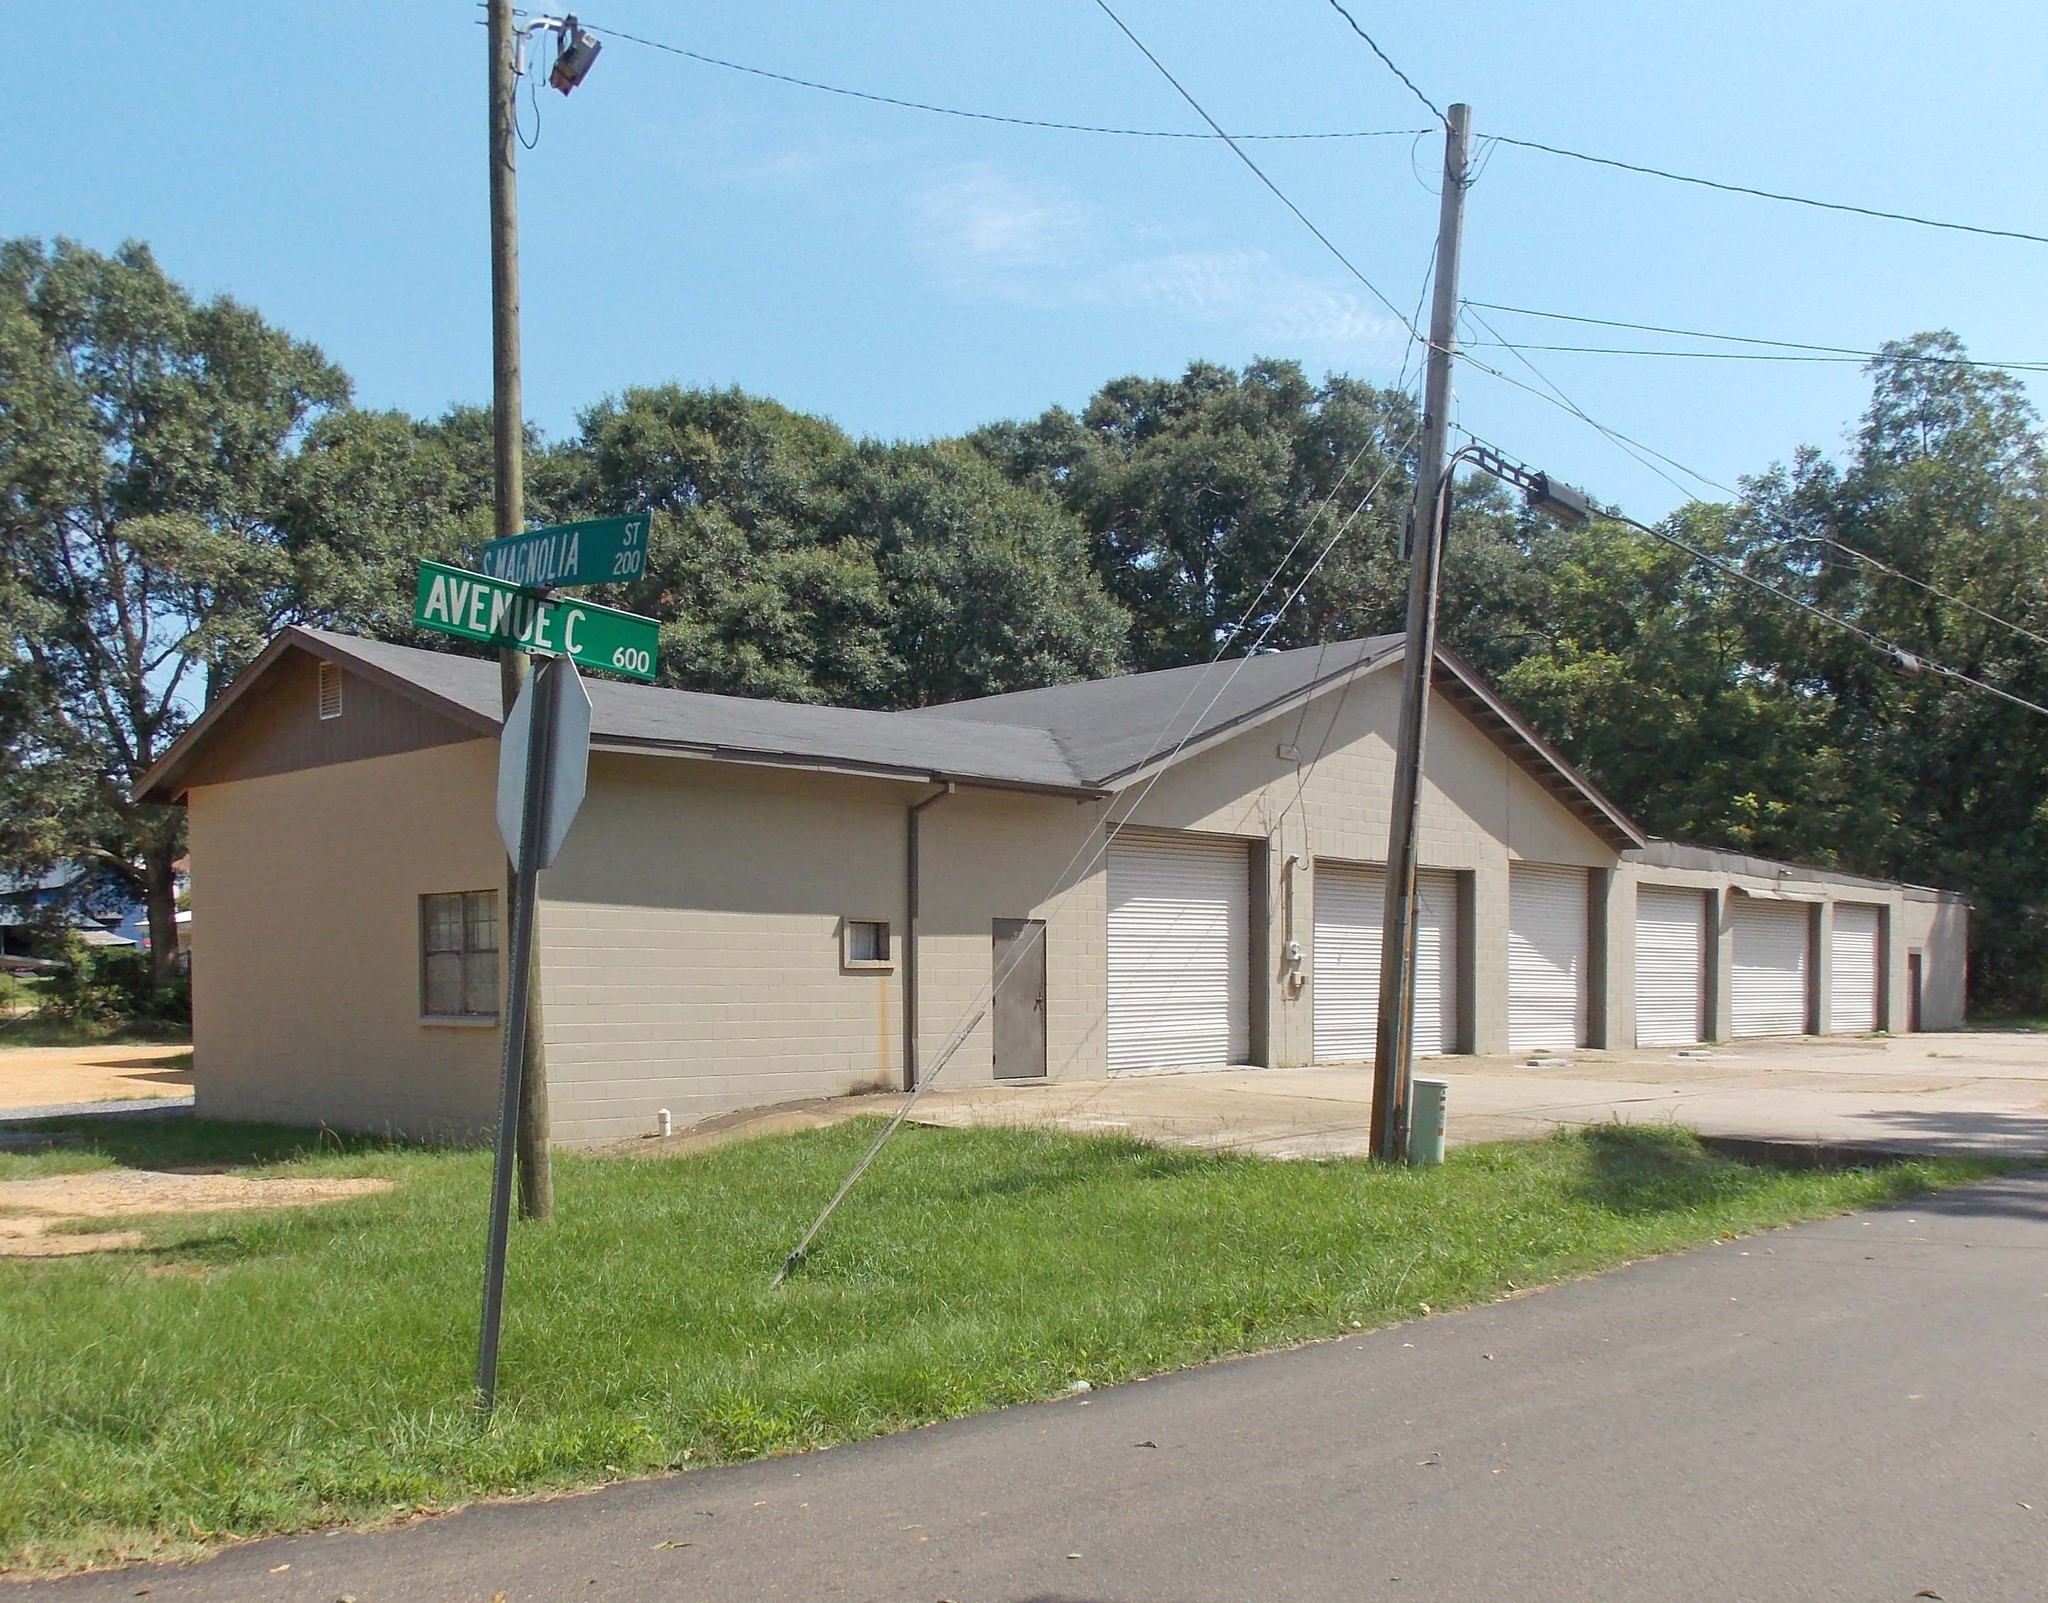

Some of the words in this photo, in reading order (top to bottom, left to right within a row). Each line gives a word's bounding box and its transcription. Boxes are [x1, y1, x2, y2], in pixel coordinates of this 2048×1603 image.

[495, 532, 579, 584] MAGNOLIA
[622, 521, 641, 546] ST
[612, 550, 641, 576] 200
[423, 575, 554, 648] AVENUE
[564, 609, 586, 654] C
[612, 646, 650, 673] 600
